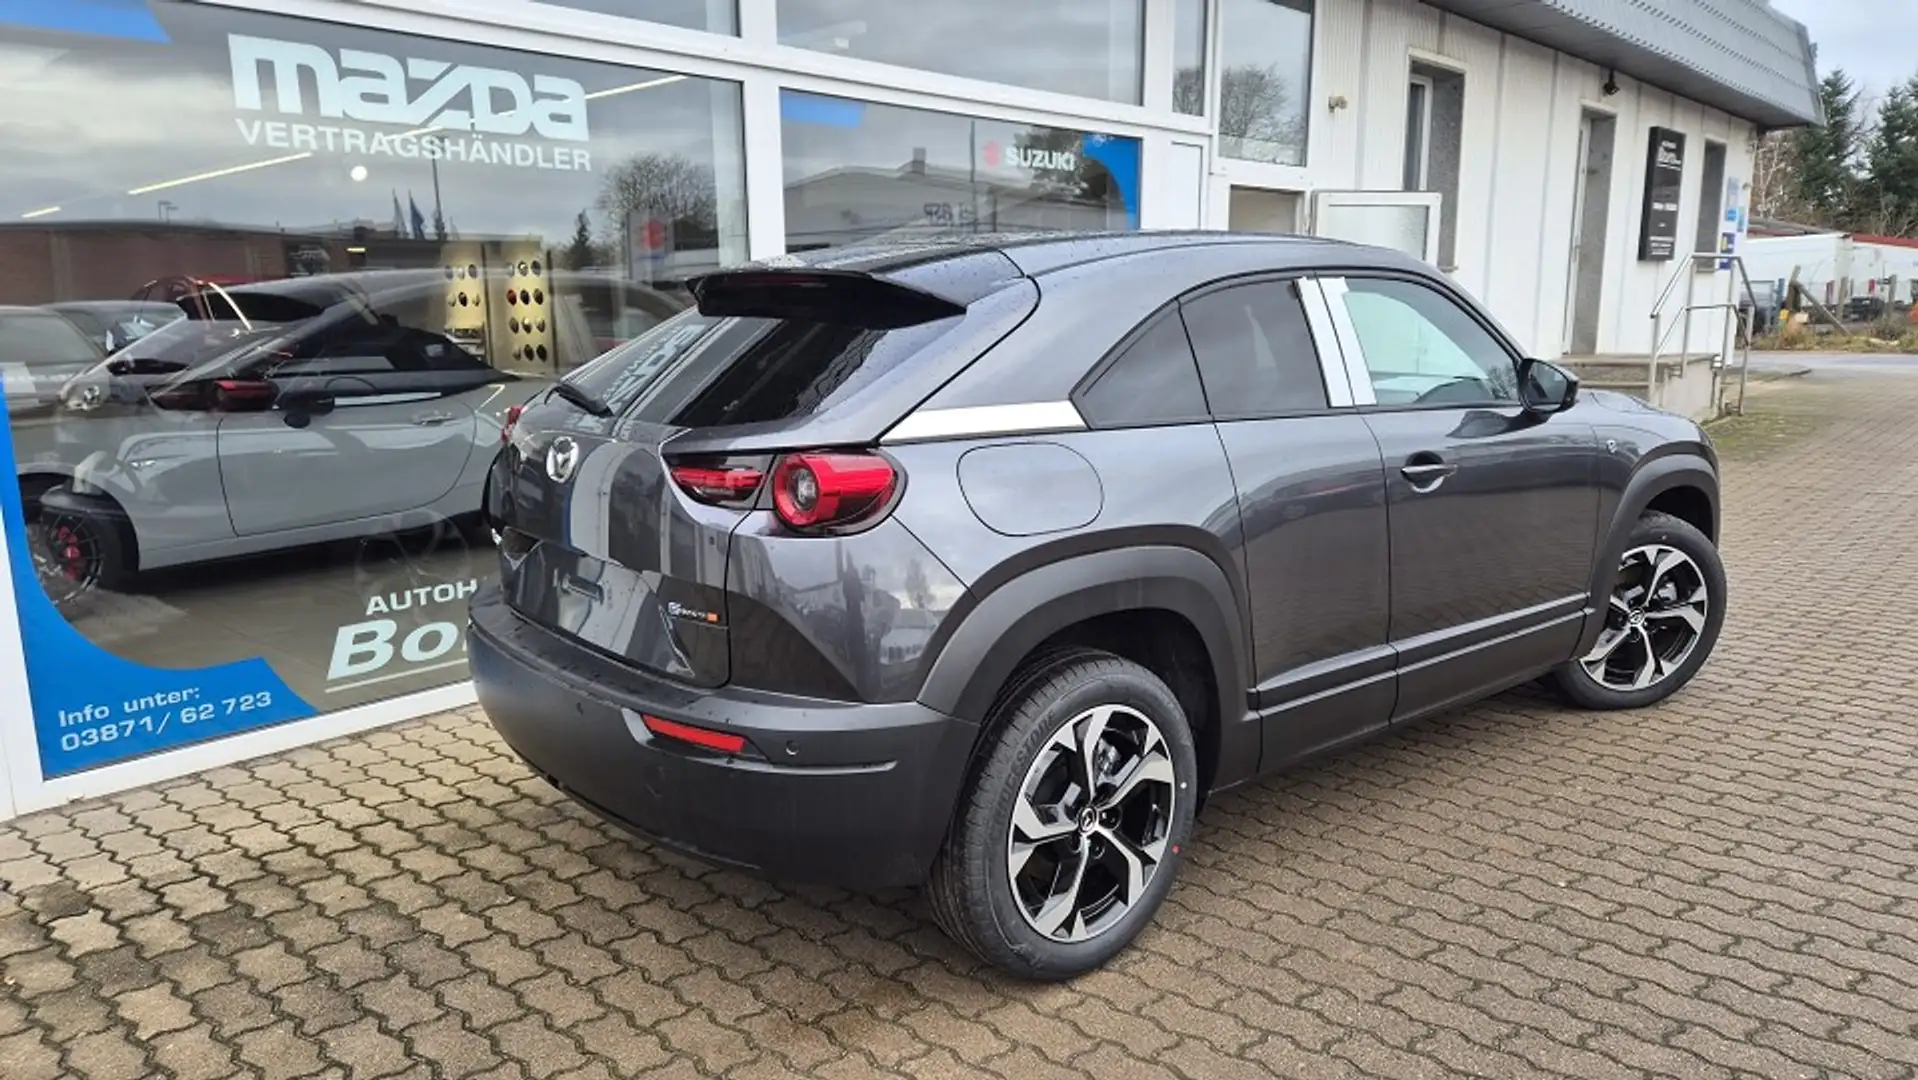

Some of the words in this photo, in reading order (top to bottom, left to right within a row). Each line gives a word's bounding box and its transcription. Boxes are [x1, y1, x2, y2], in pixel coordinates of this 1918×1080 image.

[235, 118, 592, 172] VERTRAGSHÄNDLER
[1005, 146, 1075, 172] SUZUKI
[366, 578, 478, 616] AUTOH
[327, 617, 470, 681] Bo
[58, 703, 110, 728] Info
[123, 686, 201, 714] unter:
[61, 711, 171, 752] 03871/
[180, 702, 215, 725] 62
[222, 690, 273, 716] 723
[993, 710, 1056, 840] RIDGESTONE
